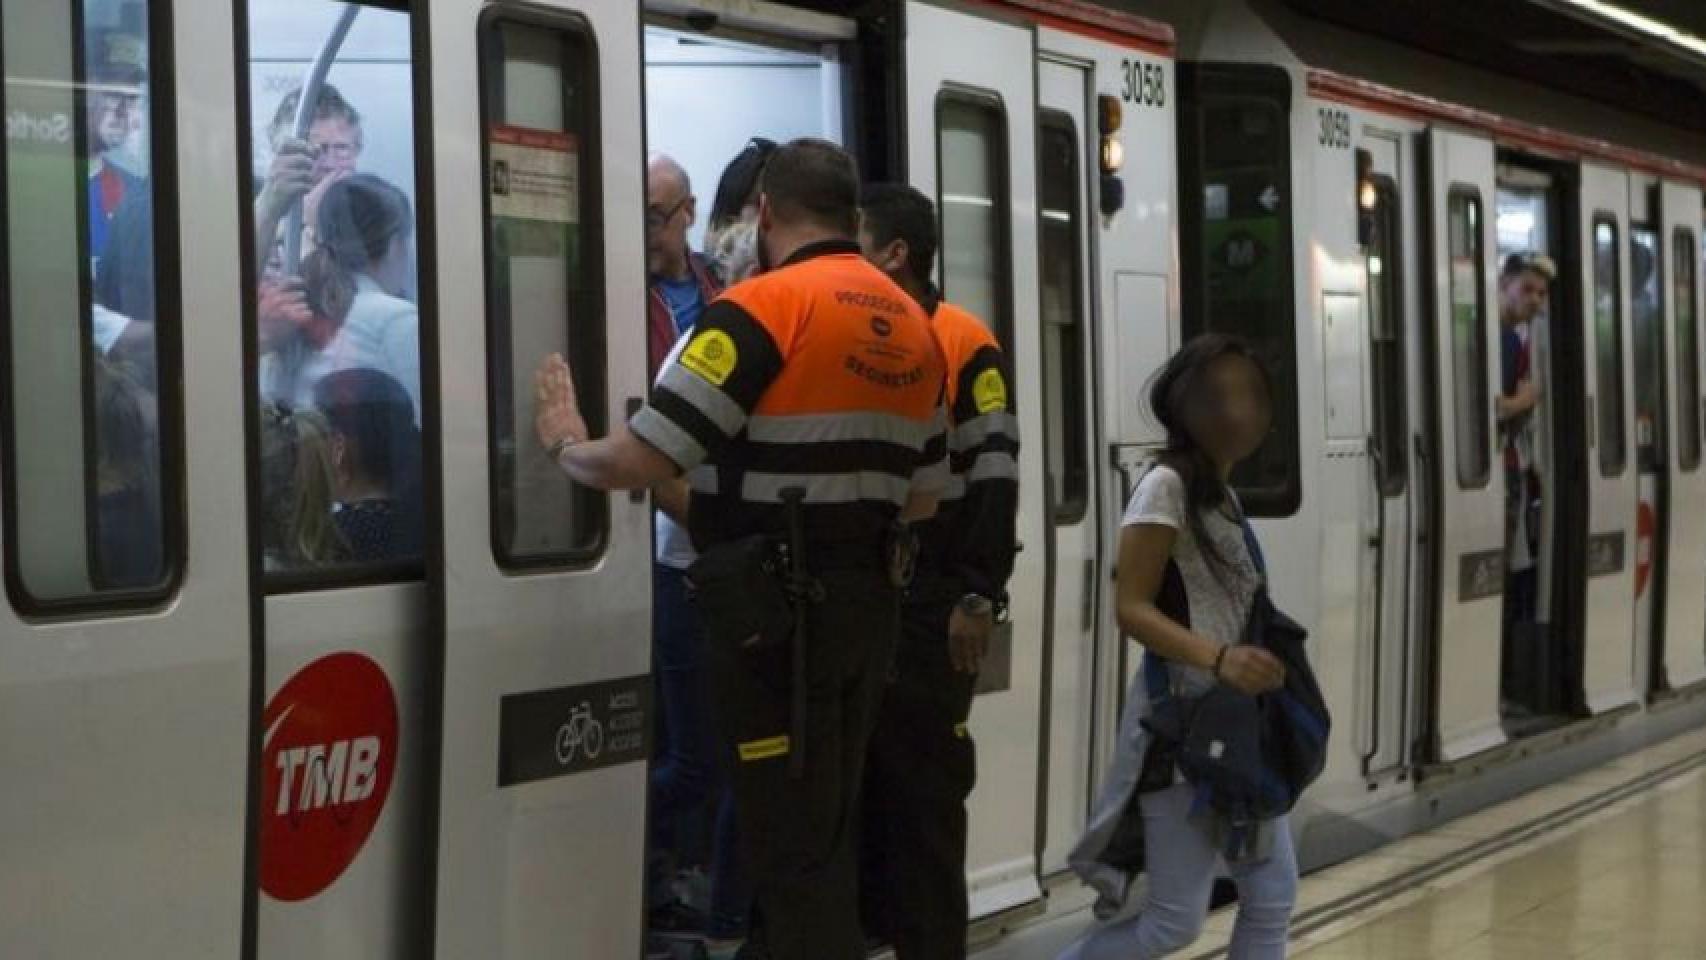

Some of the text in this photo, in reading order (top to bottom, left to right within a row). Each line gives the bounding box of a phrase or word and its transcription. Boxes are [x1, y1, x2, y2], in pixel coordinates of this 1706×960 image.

[1121, 58, 1165, 107] 3058
[1317, 108, 1350, 148] 3059
[276, 735, 381, 816] TMB
